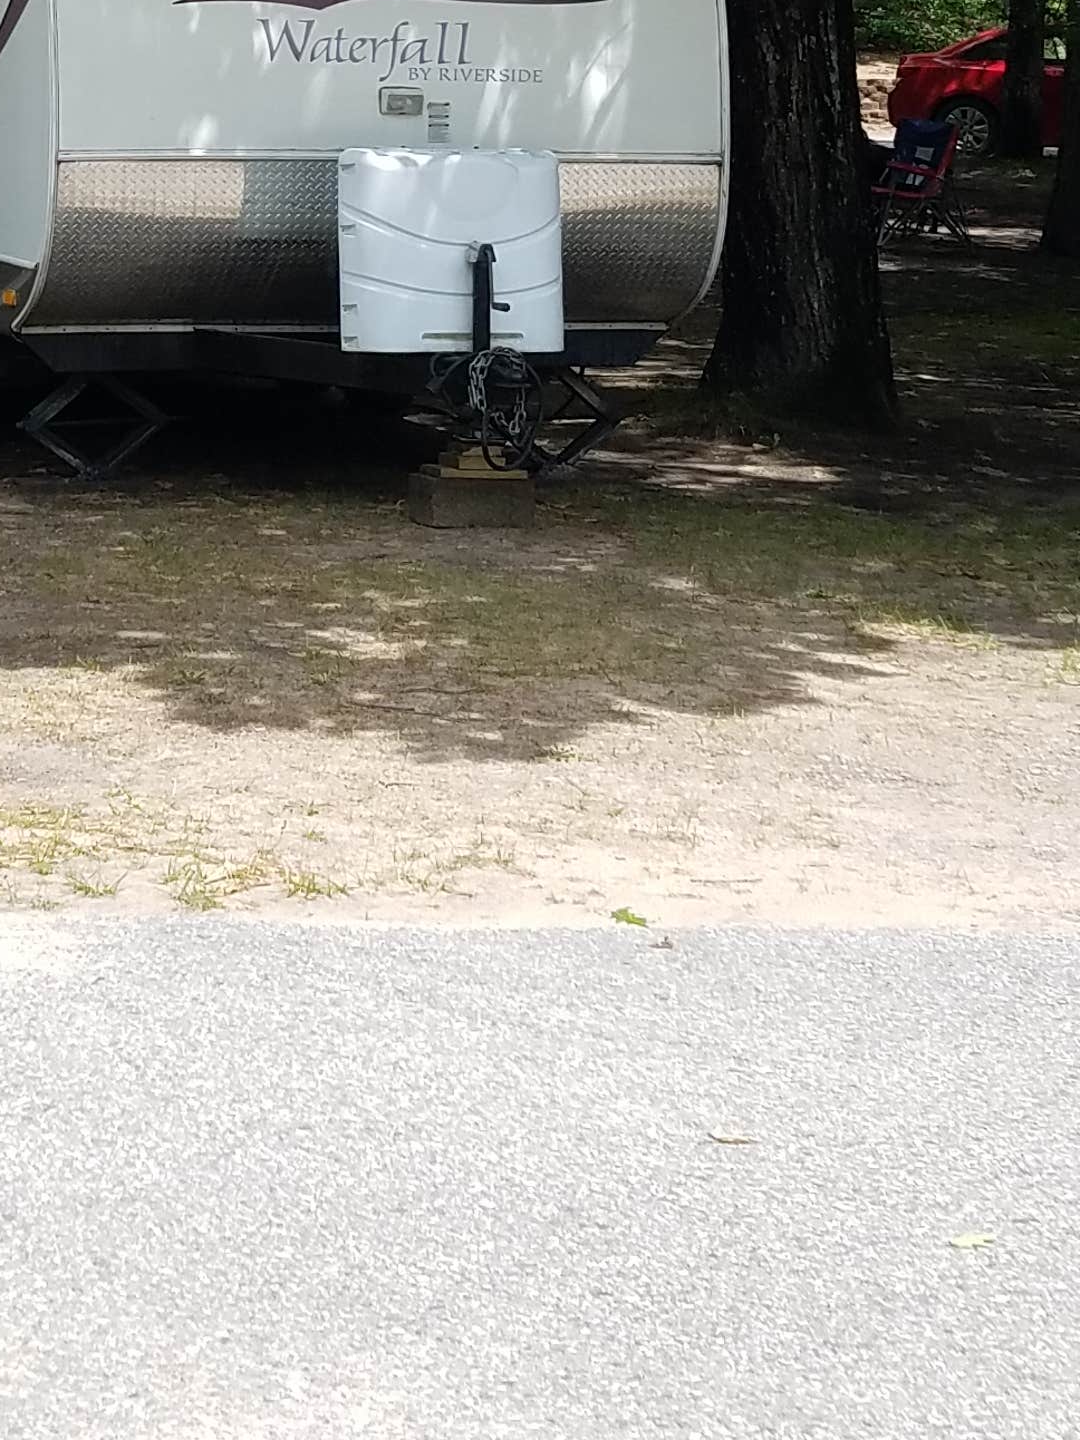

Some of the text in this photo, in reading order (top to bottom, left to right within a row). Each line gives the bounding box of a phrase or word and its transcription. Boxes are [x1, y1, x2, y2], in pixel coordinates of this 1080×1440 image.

[256, 18, 471, 82] Waterfall
[408, 67, 543, 83] BY RIVERSIDE
